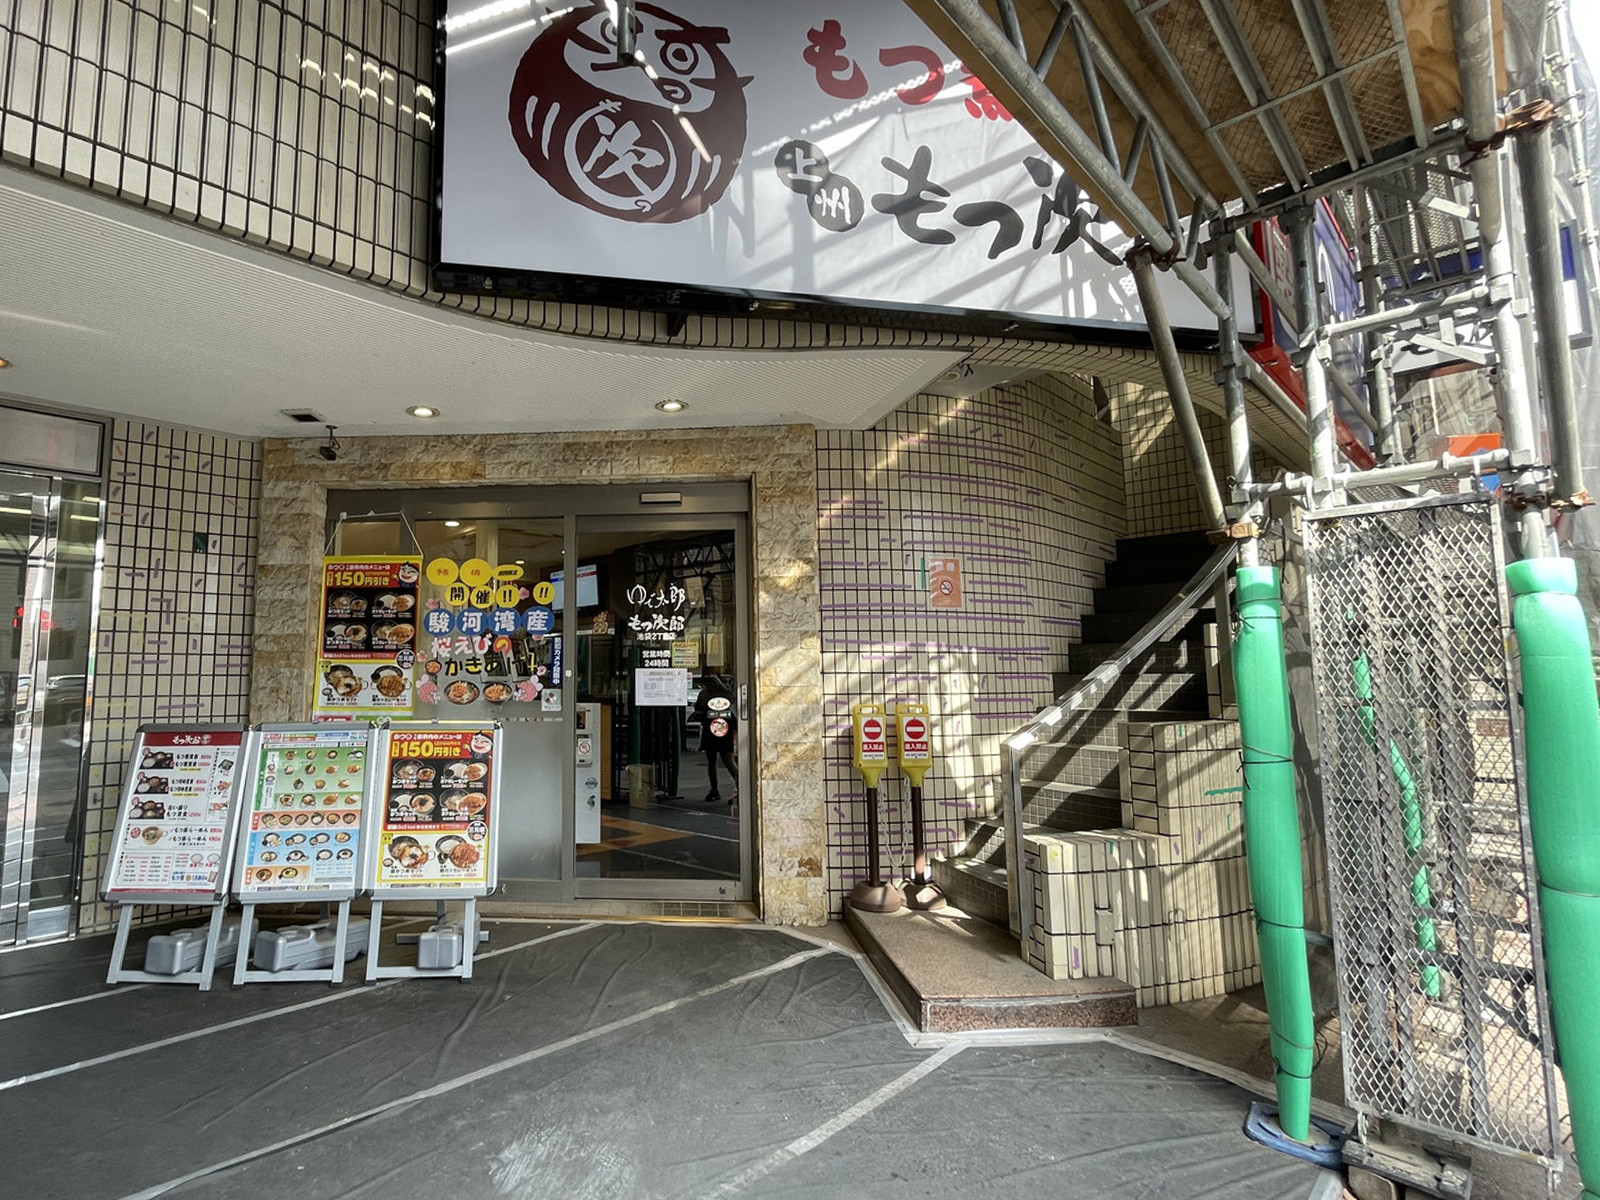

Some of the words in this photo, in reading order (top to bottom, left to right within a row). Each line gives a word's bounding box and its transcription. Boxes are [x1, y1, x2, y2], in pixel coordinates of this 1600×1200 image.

[627, 583, 686, 611] ゆで太郎
[429, 610, 549, 633] 駿河湾産
[628, 614, 686, 632] もつ次郎
[432, 633, 512, 658] 桜えびの
[644, 659, 669, 667] 24時間
